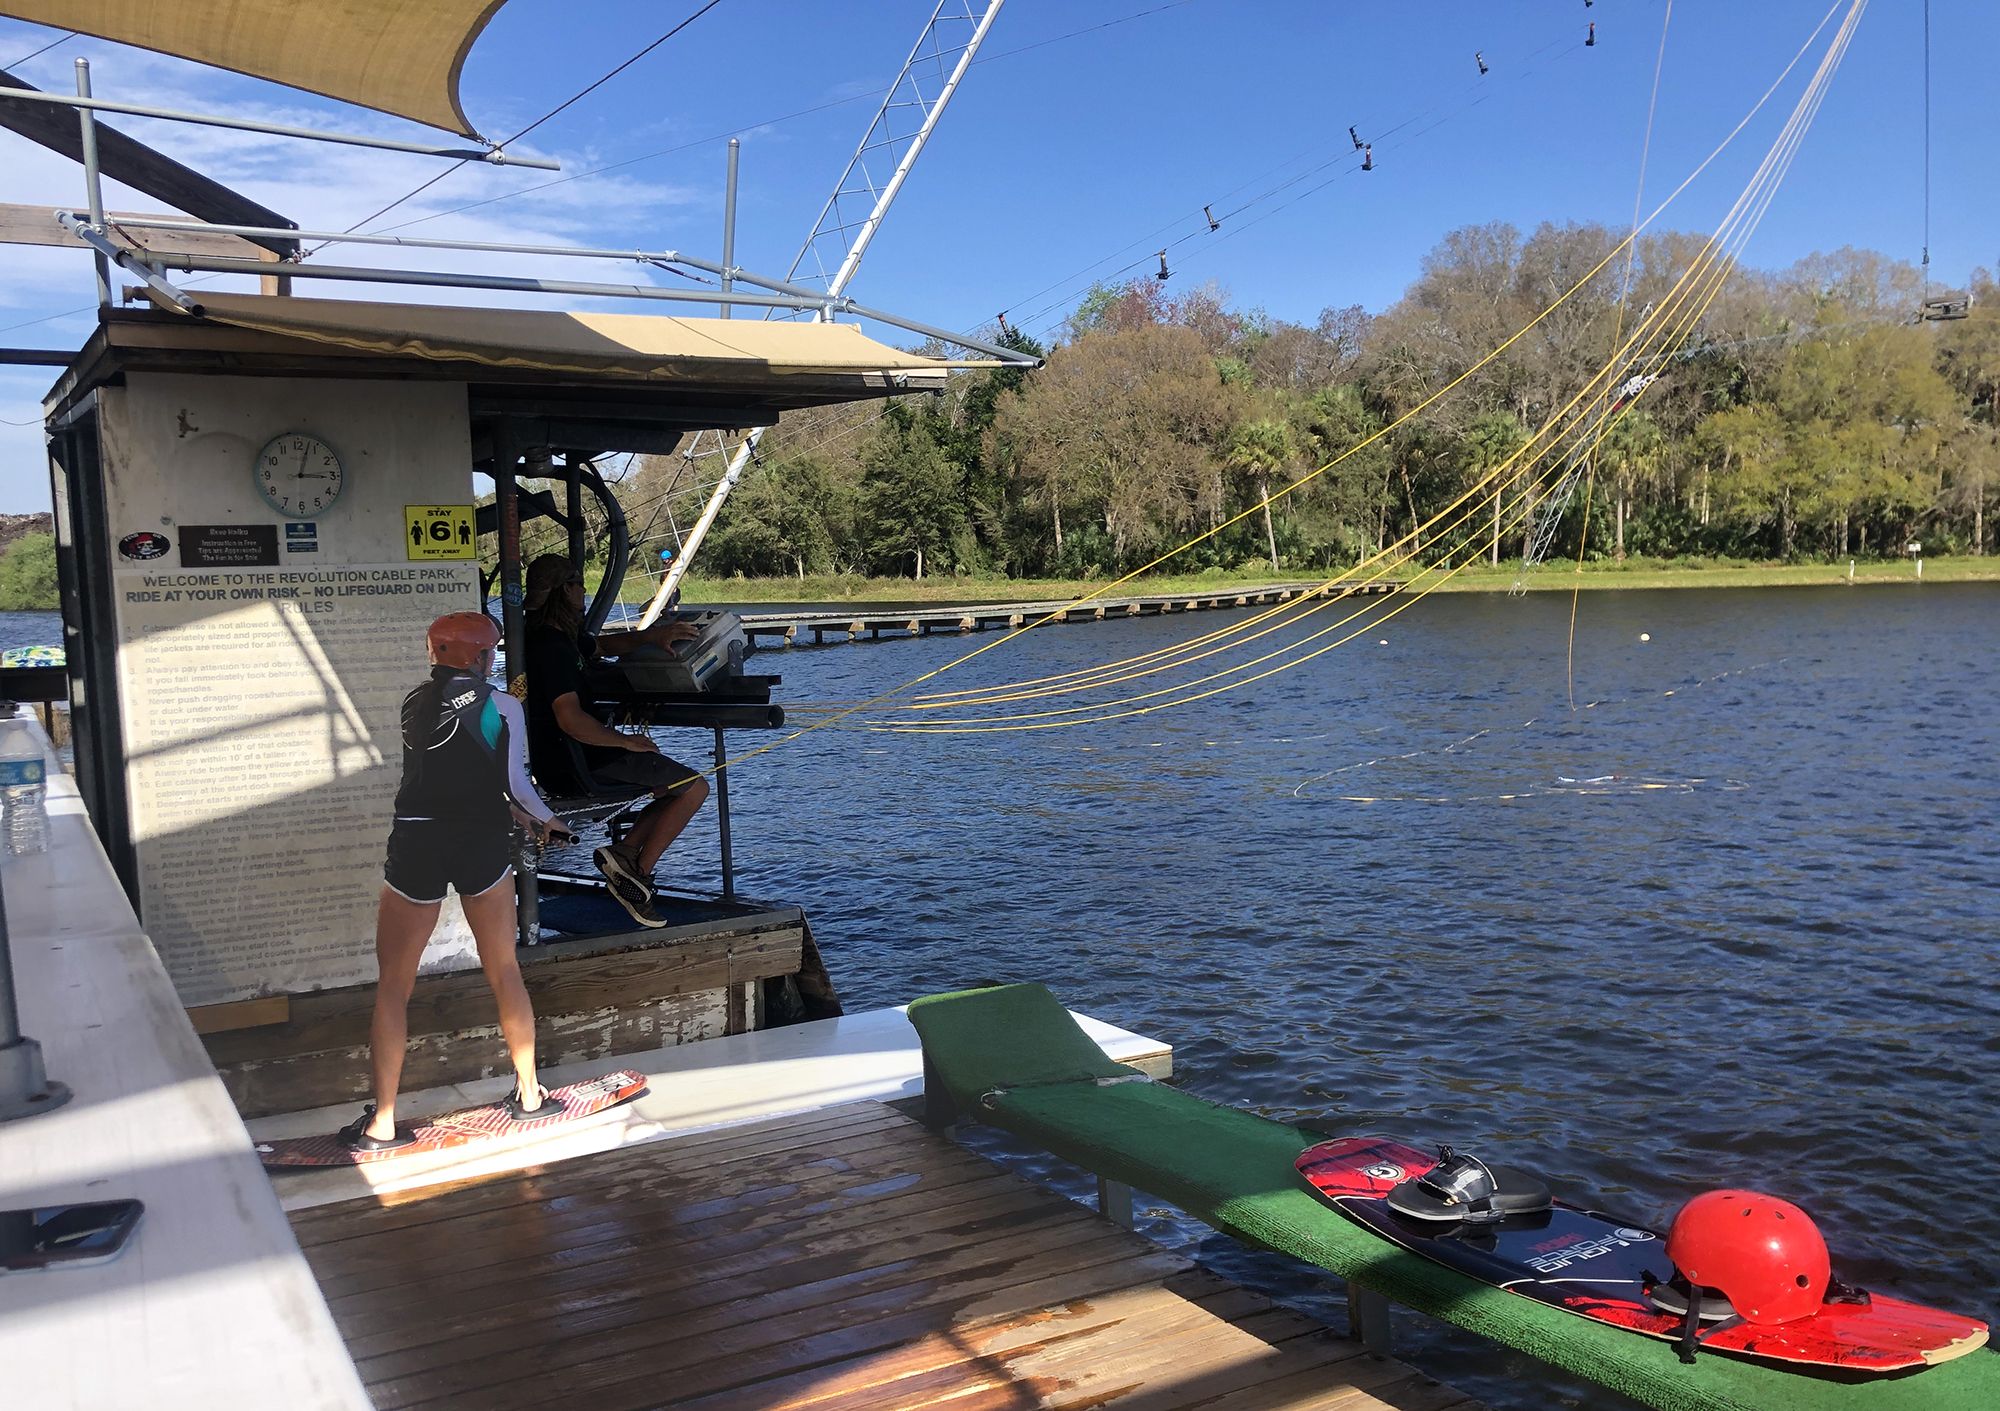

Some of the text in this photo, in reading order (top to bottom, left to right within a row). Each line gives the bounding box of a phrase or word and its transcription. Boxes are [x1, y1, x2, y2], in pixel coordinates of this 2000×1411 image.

[280, 446, 287, 454] 11
[293, 441, 303, 450] 12
[269, 457, 278, 466] 10
[324, 457, 331, 465] 2
[265, 471, 271, 480] 9
[330, 472, 336, 480] 3
[271, 486, 277, 495] 8
[325, 487, 331, 495] 4
[283, 497, 289, 506] 7
[299, 501, 305, 511] 6
[315, 498, 321, 507] 5
[430, 521, 451, 541] 6
[143, 570, 455, 587] WELCOME TO THE REVOLUTION CABLE PARK
[126, 591, 161, 603] RIDE
[164, 591, 183, 602] AT
[186, 589, 227, 601] YOUR
[230, 588, 264, 600] OWN
[268, 587, 300, 599] RISK
[314, 586, 334, 597] NO
[338, 584, 413, 597] LIFEGUARD
[416, 584, 435, 594] ON
[438, 583, 471, 594] DUTY
[281, 602, 334, 614] RULES
